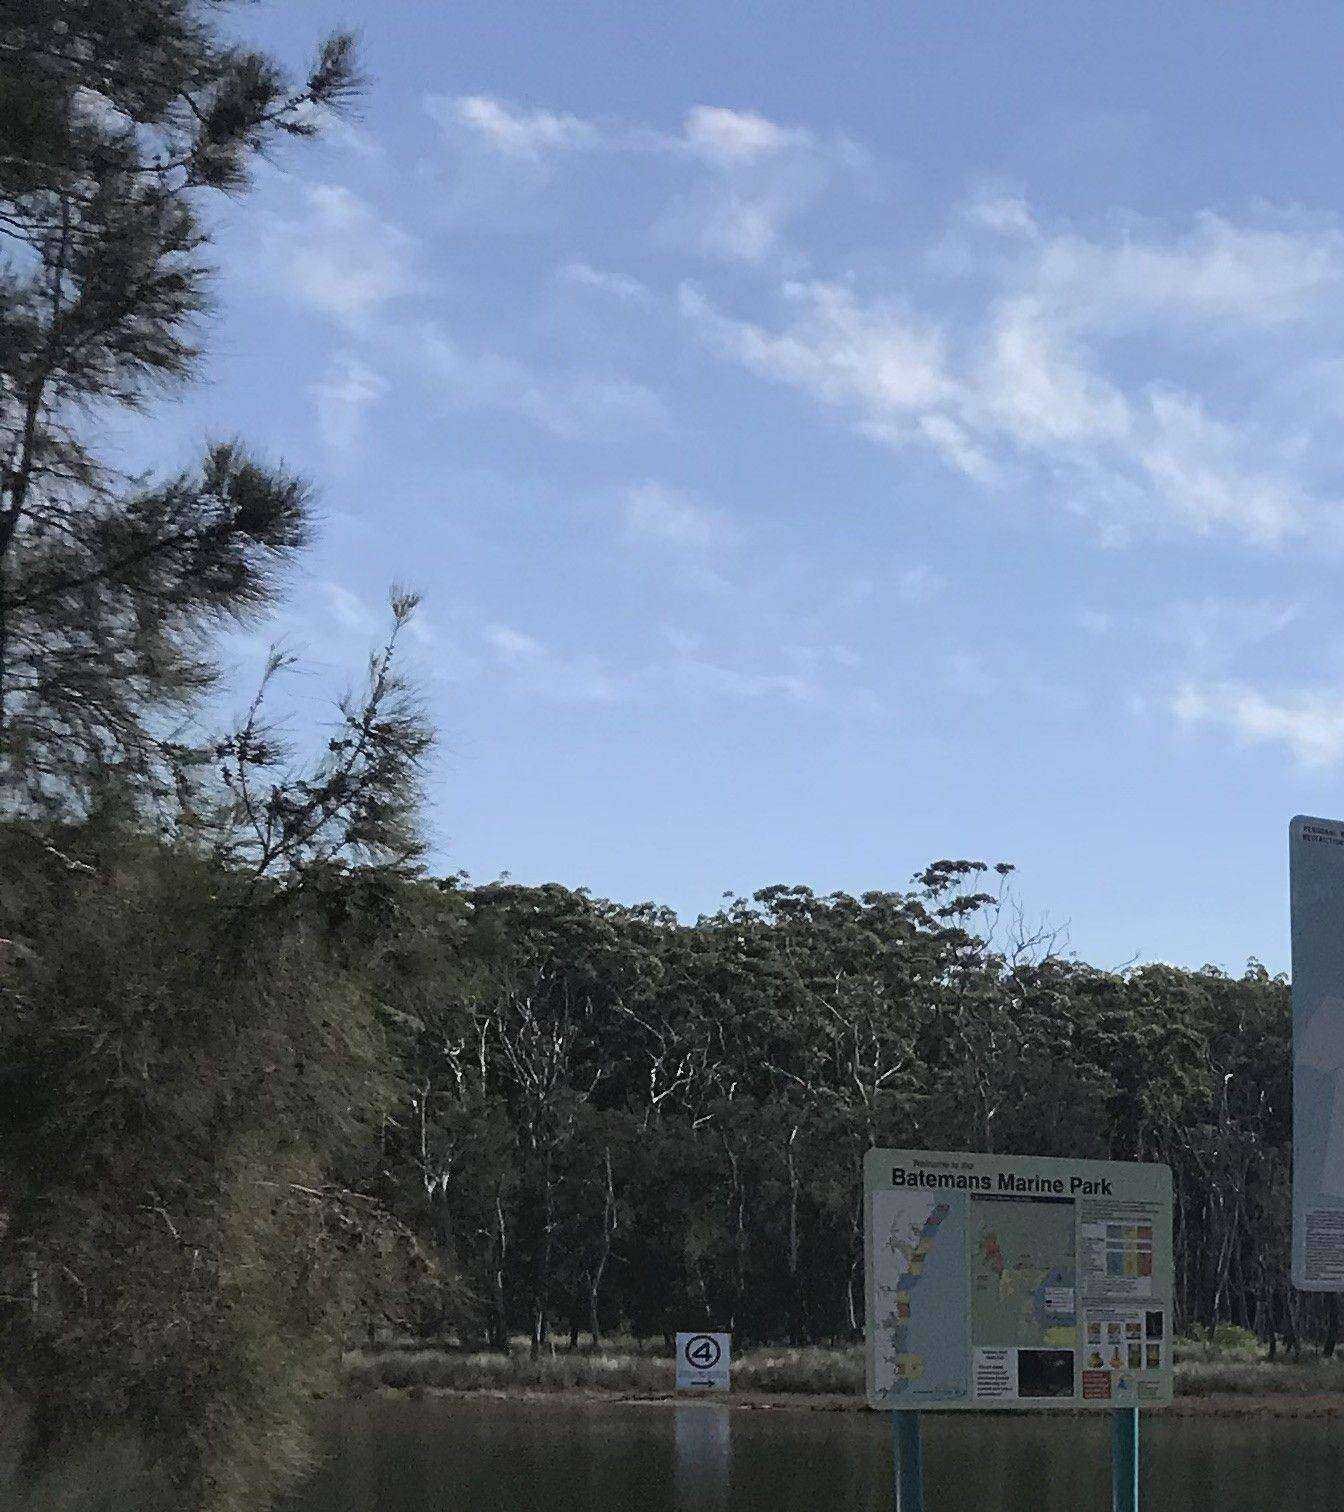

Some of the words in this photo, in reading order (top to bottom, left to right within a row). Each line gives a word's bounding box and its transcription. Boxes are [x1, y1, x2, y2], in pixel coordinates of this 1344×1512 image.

[891, 1167, 992, 1190] Batemans
[997, 1172, 1064, 1194] Marine
[1069, 1176, 1113, 1196] Park
[691, 1341, 712, 1362] 4
